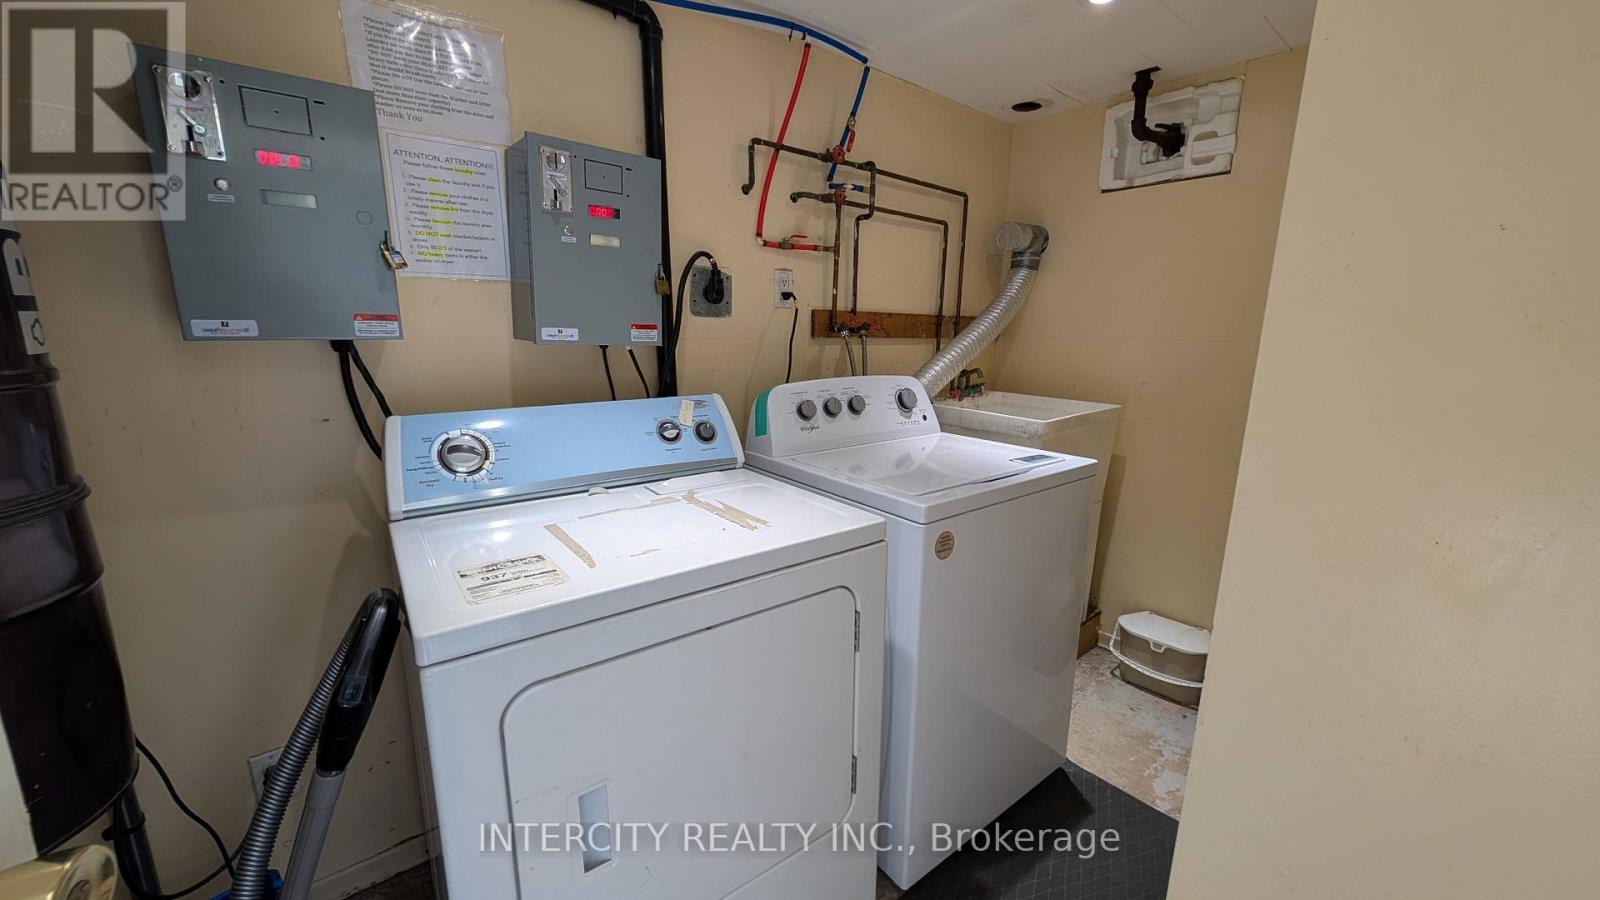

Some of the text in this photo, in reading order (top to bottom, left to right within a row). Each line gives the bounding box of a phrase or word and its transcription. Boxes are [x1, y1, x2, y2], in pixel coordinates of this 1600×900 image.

[377, 108, 423, 122] Thank You
[393, 149, 443, 163] ATTENTION,
[480, 572, 507, 582] 937
